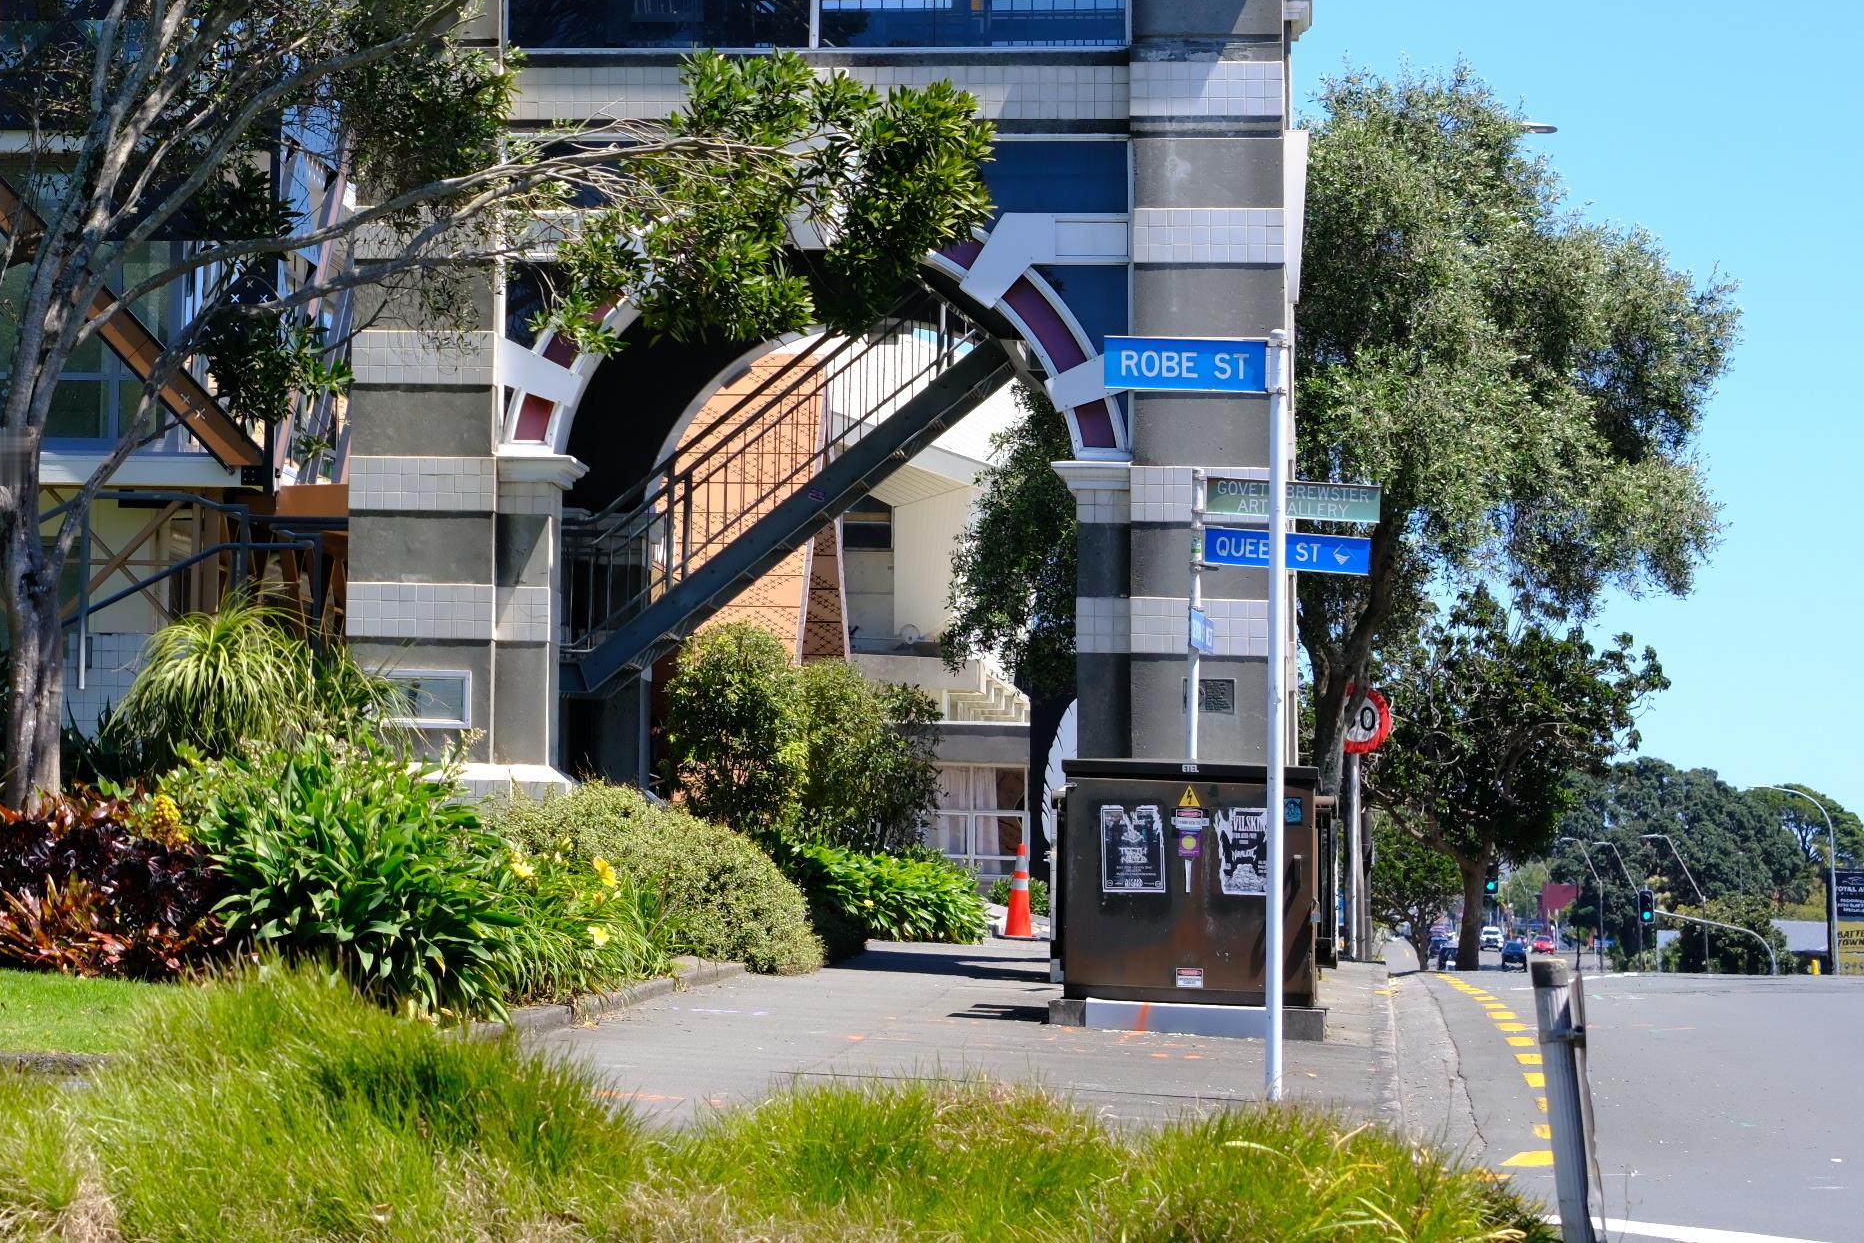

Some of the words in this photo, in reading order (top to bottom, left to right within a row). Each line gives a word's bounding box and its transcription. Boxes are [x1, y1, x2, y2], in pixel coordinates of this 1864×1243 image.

[1120, 349, 1199, 379] ROBE
[1213, 352, 1250, 380] ST
[1217, 480, 1270, 497] GOVET
[1285, 484, 1369, 503] BREWSTER
[1237, 498, 1269, 514] ART
[1285, 501, 1349, 518] ALLERY
[1215, 536, 1270, 559] QUEE
[1295, 541, 1322, 563] ST
